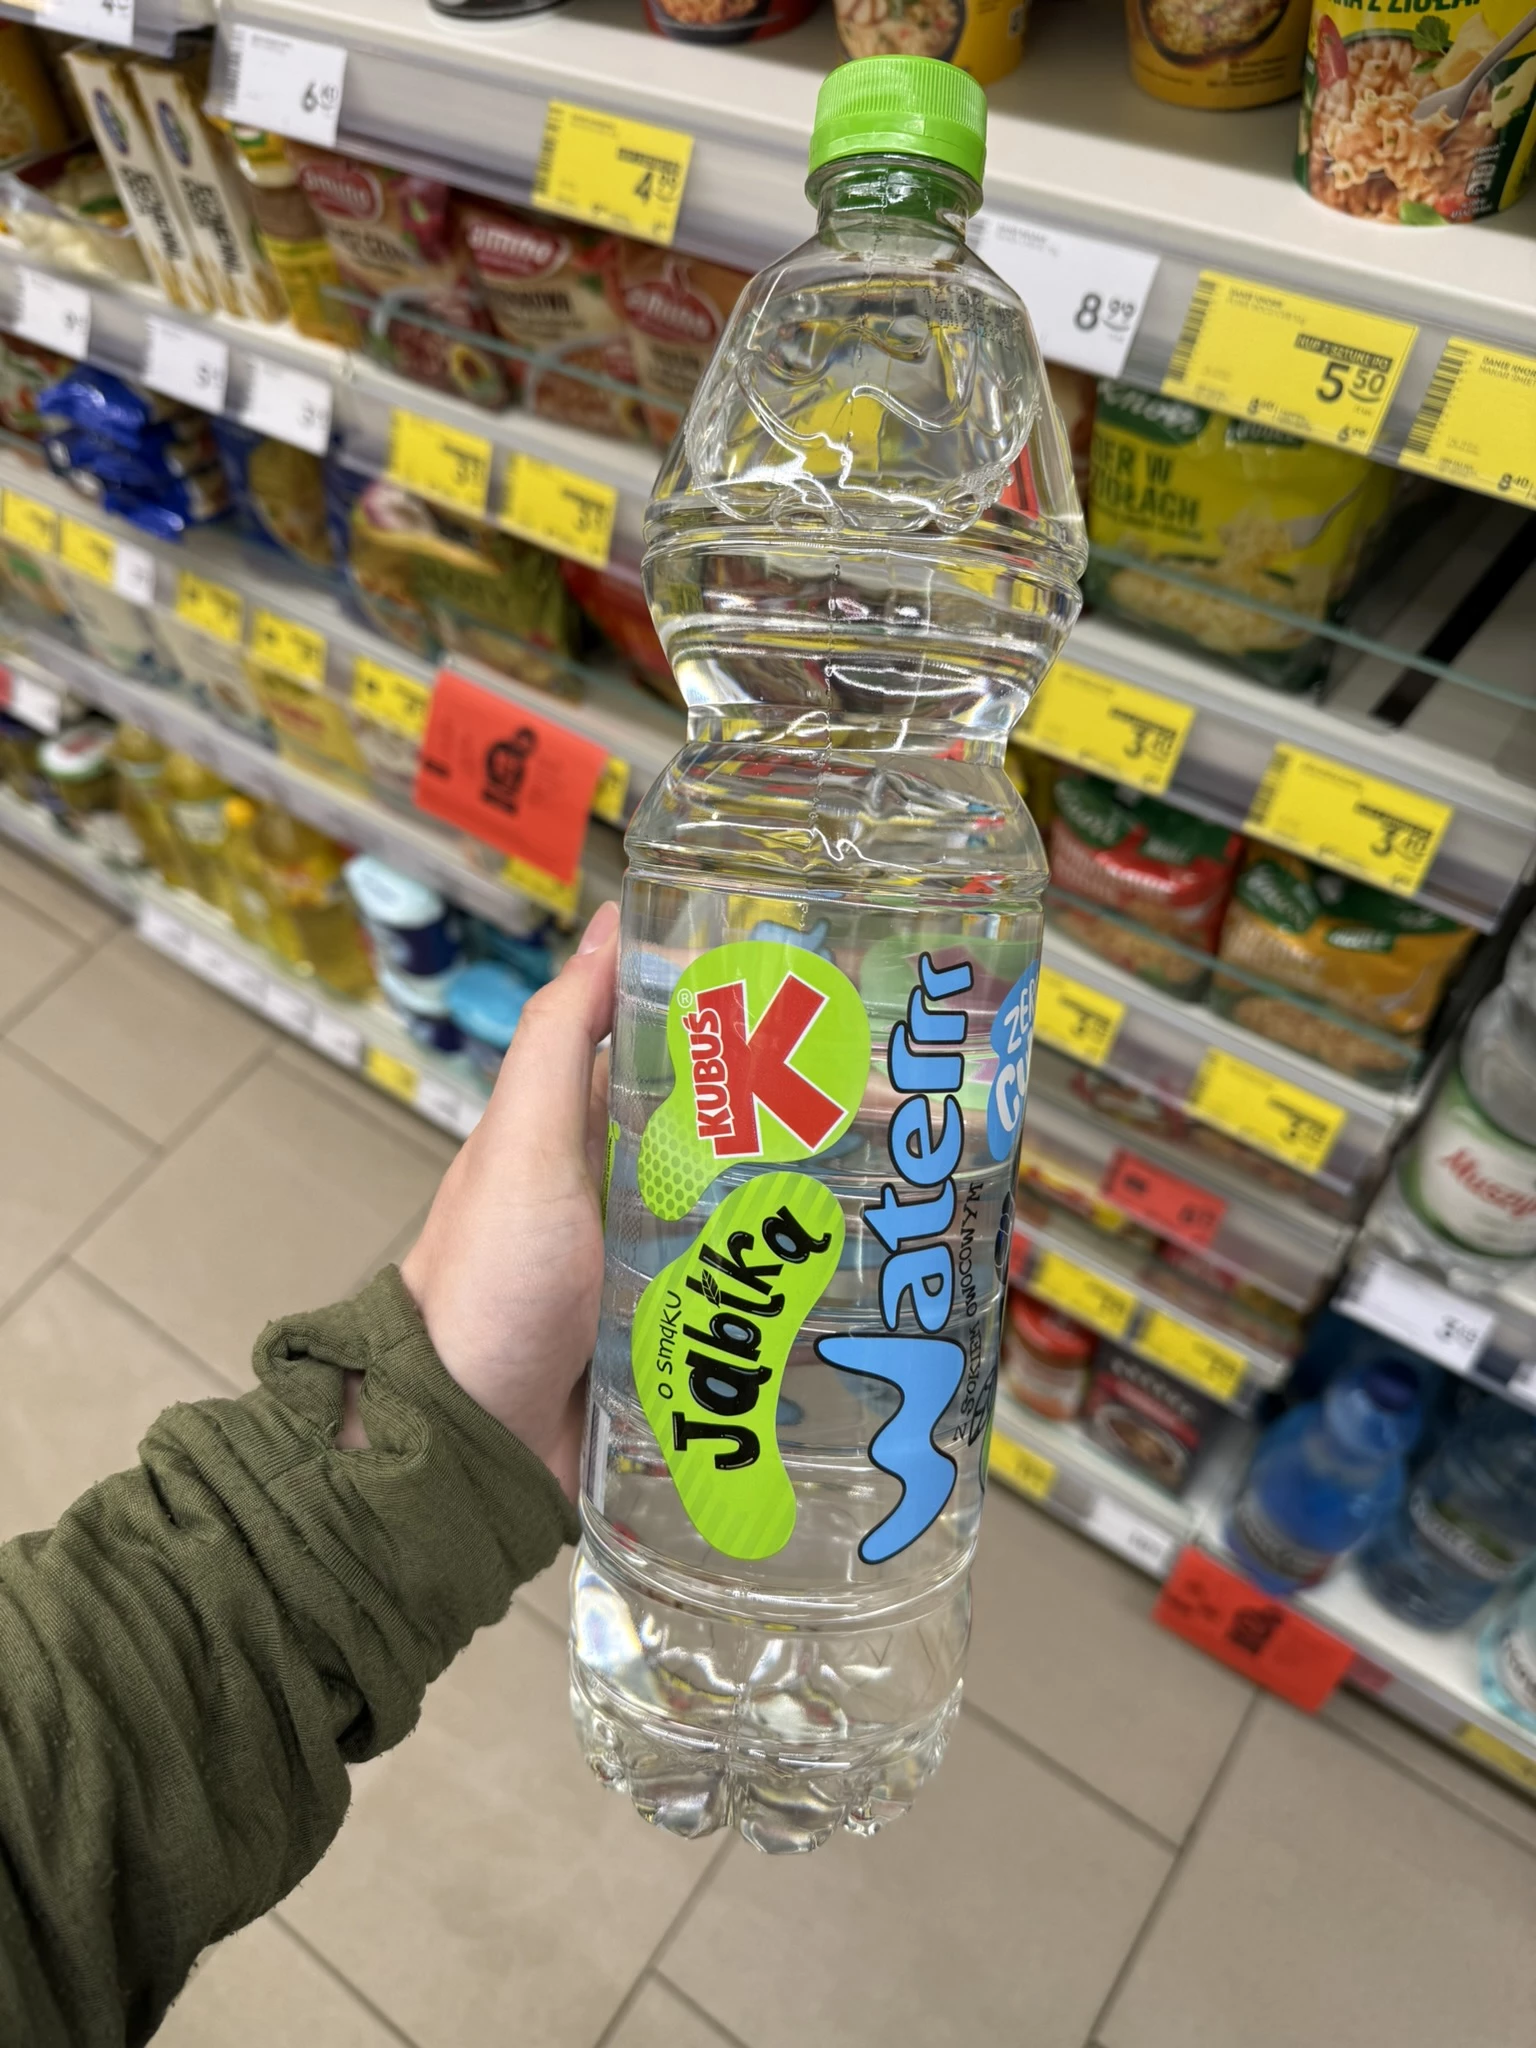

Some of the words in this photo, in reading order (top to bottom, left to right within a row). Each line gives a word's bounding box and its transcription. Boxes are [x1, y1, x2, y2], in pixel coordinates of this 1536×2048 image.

[681, 1007, 736, 1140] KUBUŚ
[1004, 972, 1039, 1054] ZER
[814, 951, 975, 1565] Waterr
[958, 1181, 984, 1317] OWOCOWYM
[656, 1289, 682, 1375] smaku
[672, 1205, 832, 1470] Jabłka
[961, 1320, 982, 1414] SOKIEM
